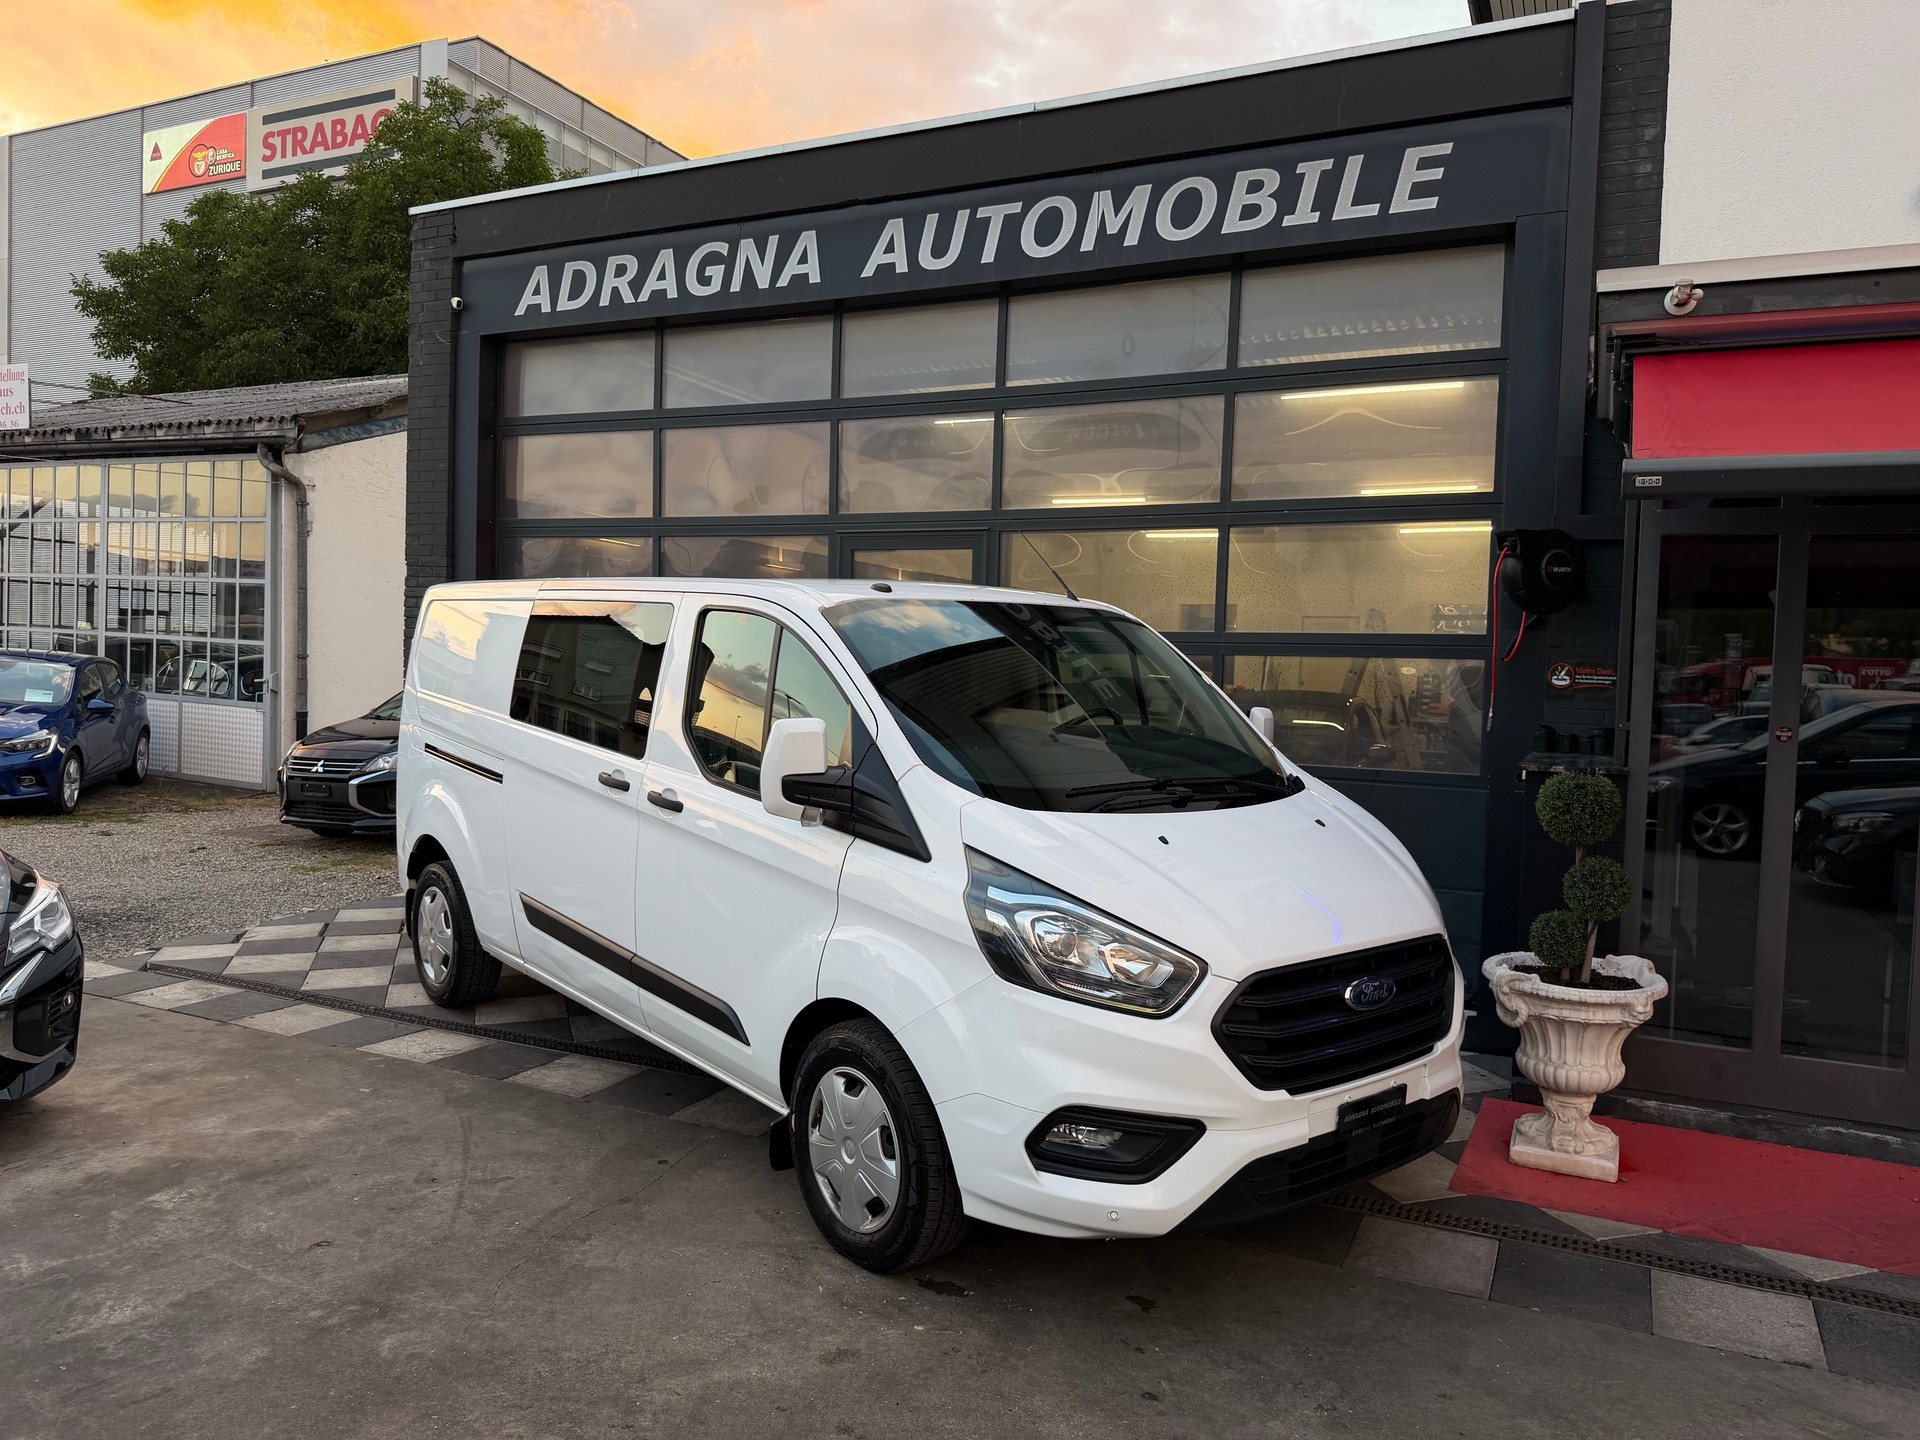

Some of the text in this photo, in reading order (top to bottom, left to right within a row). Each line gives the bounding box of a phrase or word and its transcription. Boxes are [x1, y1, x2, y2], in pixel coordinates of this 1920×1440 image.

[208, 160, 241, 176] ZURIQUE
[514, 142, 1454, 316] ADRAGNA AUTOMOBILE
[10, 420, 19, 428] 36
[1575, 666, 1596, 675] Vielen
[1361, 981, 1388, 1002] Ford
